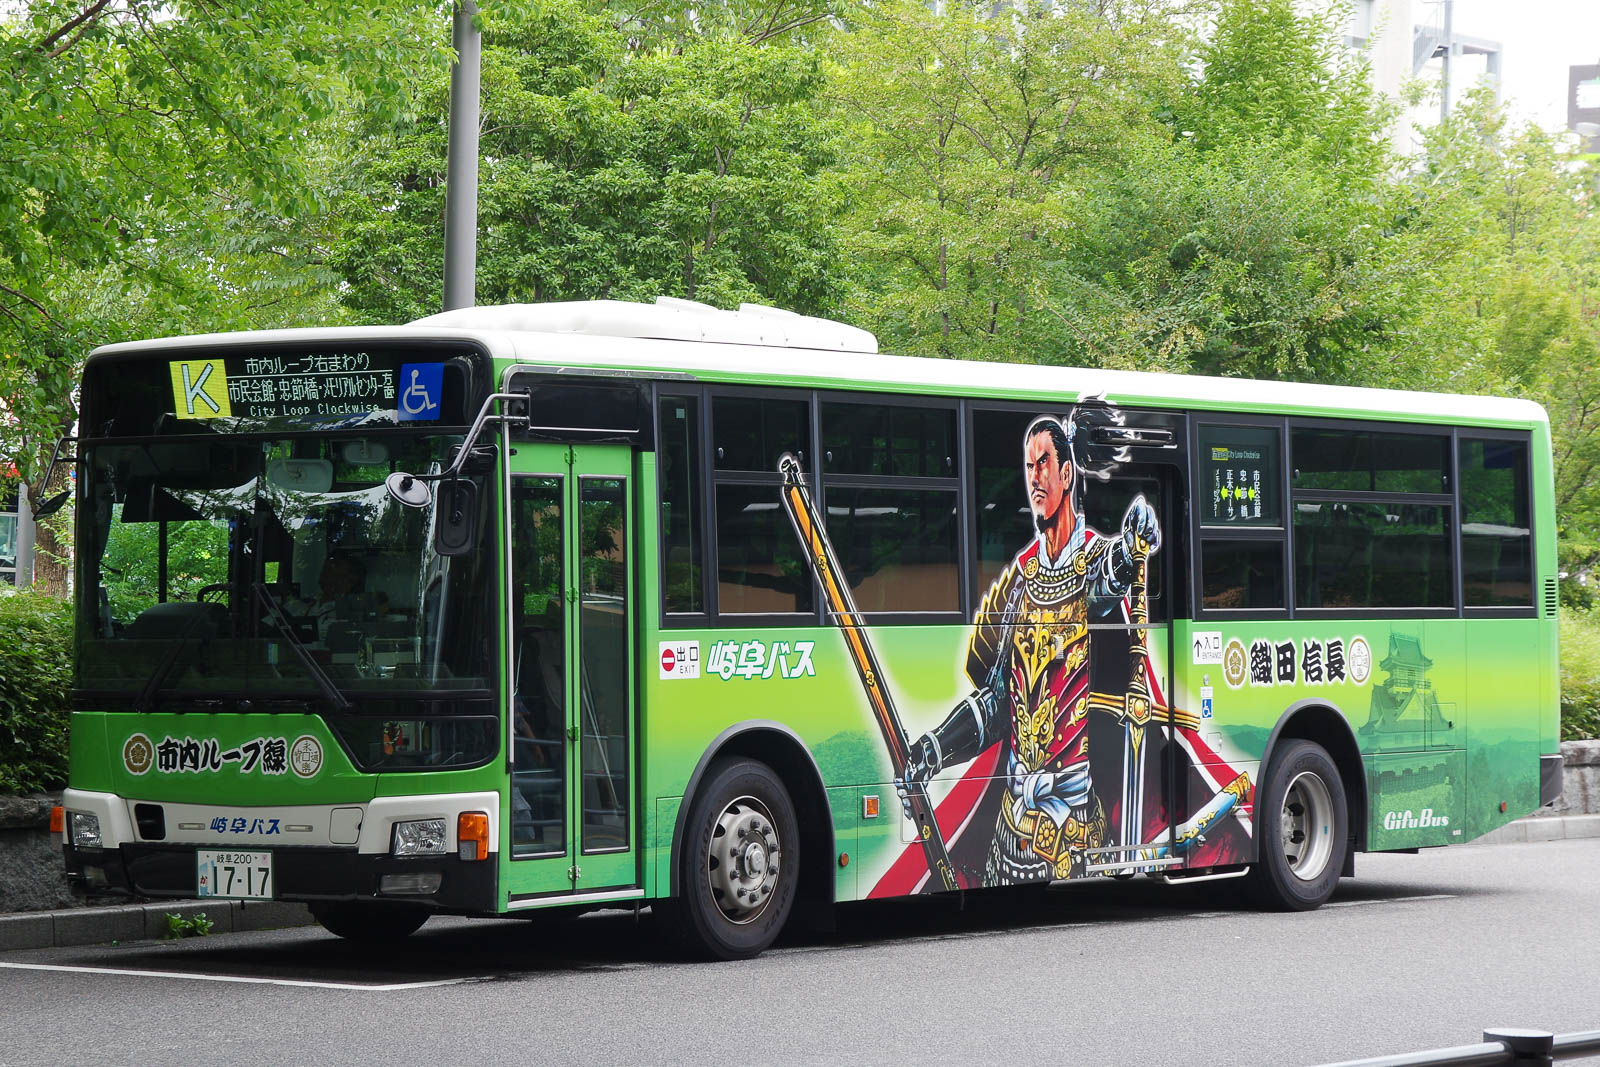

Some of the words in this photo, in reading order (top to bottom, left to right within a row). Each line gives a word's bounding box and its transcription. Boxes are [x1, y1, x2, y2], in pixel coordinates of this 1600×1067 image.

[245, 352, 370, 375] 市内ループ右まわり
[181, 363, 221, 415] K
[250, 405, 276, 417] City
[283, 403, 311, 417] Loop
[317, 401, 380, 415] Clockwise
[676, 646, 699, 662] 出口
[1204, 636, 1220, 649] 入口
[680, 665, 696, 674] EXIT
[706, 640, 817, 681] 岐阜バス
[1249, 640, 1347, 685] 織田信長
[156, 737, 289, 774] 市内ループ線
[210, 816, 281, 835] 岐阜バス
[213, 866, 270, 895] 17-17
